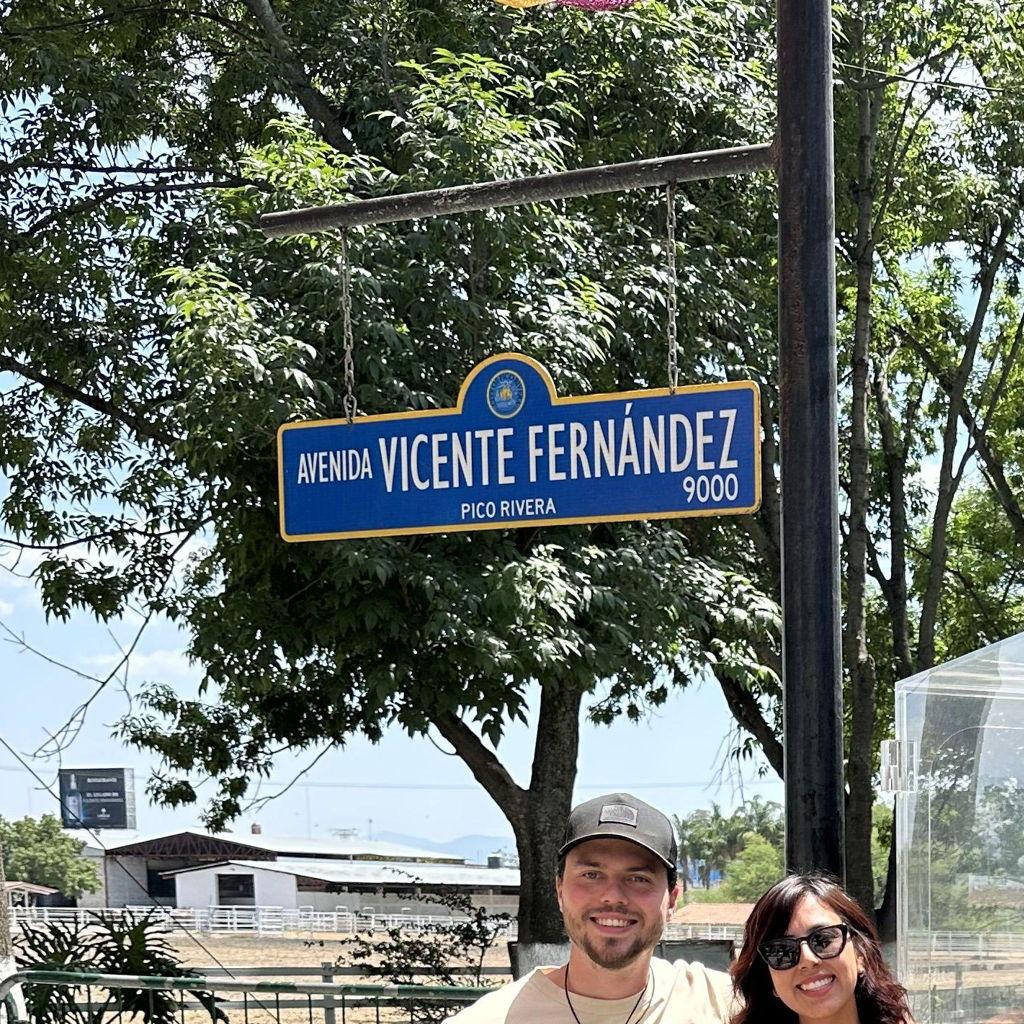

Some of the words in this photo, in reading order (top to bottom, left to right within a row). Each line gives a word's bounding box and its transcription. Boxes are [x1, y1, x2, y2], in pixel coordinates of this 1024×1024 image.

[297, 448, 373, 485] AVENIDA
[378, 428, 516, 493] VICENTE
[528, 402, 739, 483] FERNÁNDEZ
[682, 473, 739, 504] 9000
[461, 502, 496, 520] PICO
[500, 498, 557, 517] RIVERA
